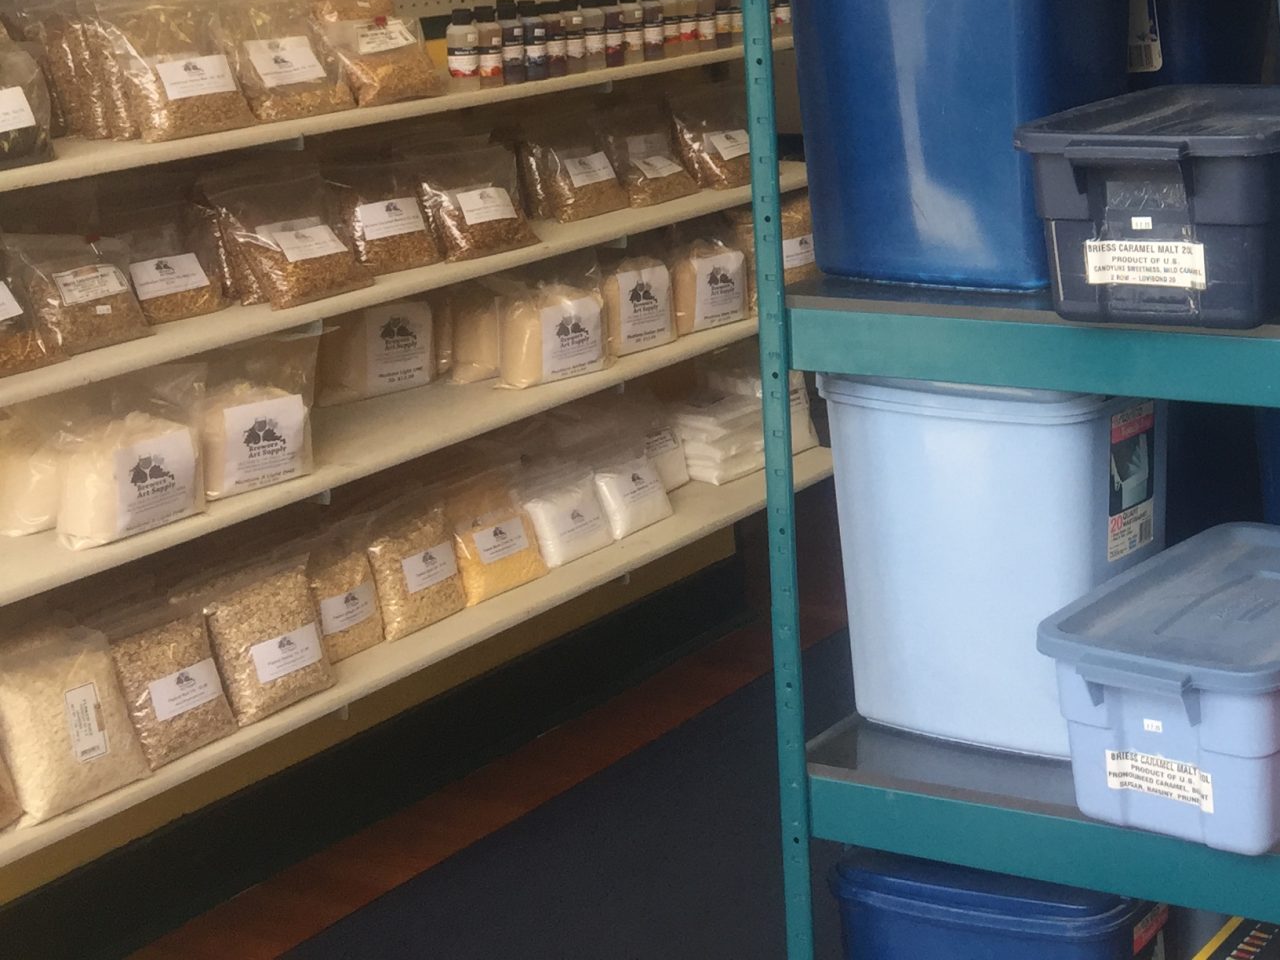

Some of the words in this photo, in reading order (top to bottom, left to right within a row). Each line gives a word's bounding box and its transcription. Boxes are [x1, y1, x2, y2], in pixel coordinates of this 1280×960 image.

[1088, 243, 1116, 252] BRIESS
[1118, 244, 1155, 253] CARAMEL
[1158, 245, 1179, 254] MALT
[1112, 256, 1147, 264] PRODUCT
[248, 451, 260, 459] Art
[262, 446, 287, 457] Supply
[137, 490, 150, 499] Art
[152, 482, 176, 495] Supply
[1110, 514, 1123, 533] 20
[1110, 751, 1139, 763] BRIESS
[1140, 755, 1174, 772] CARAMEL
[1176, 763, 1198, 777] MALT
[1108, 771, 1154, 784] PRONOUNCED
[1131, 764, 1164, 778] PRODUCT
[1167, 773, 1177, 781] OF
